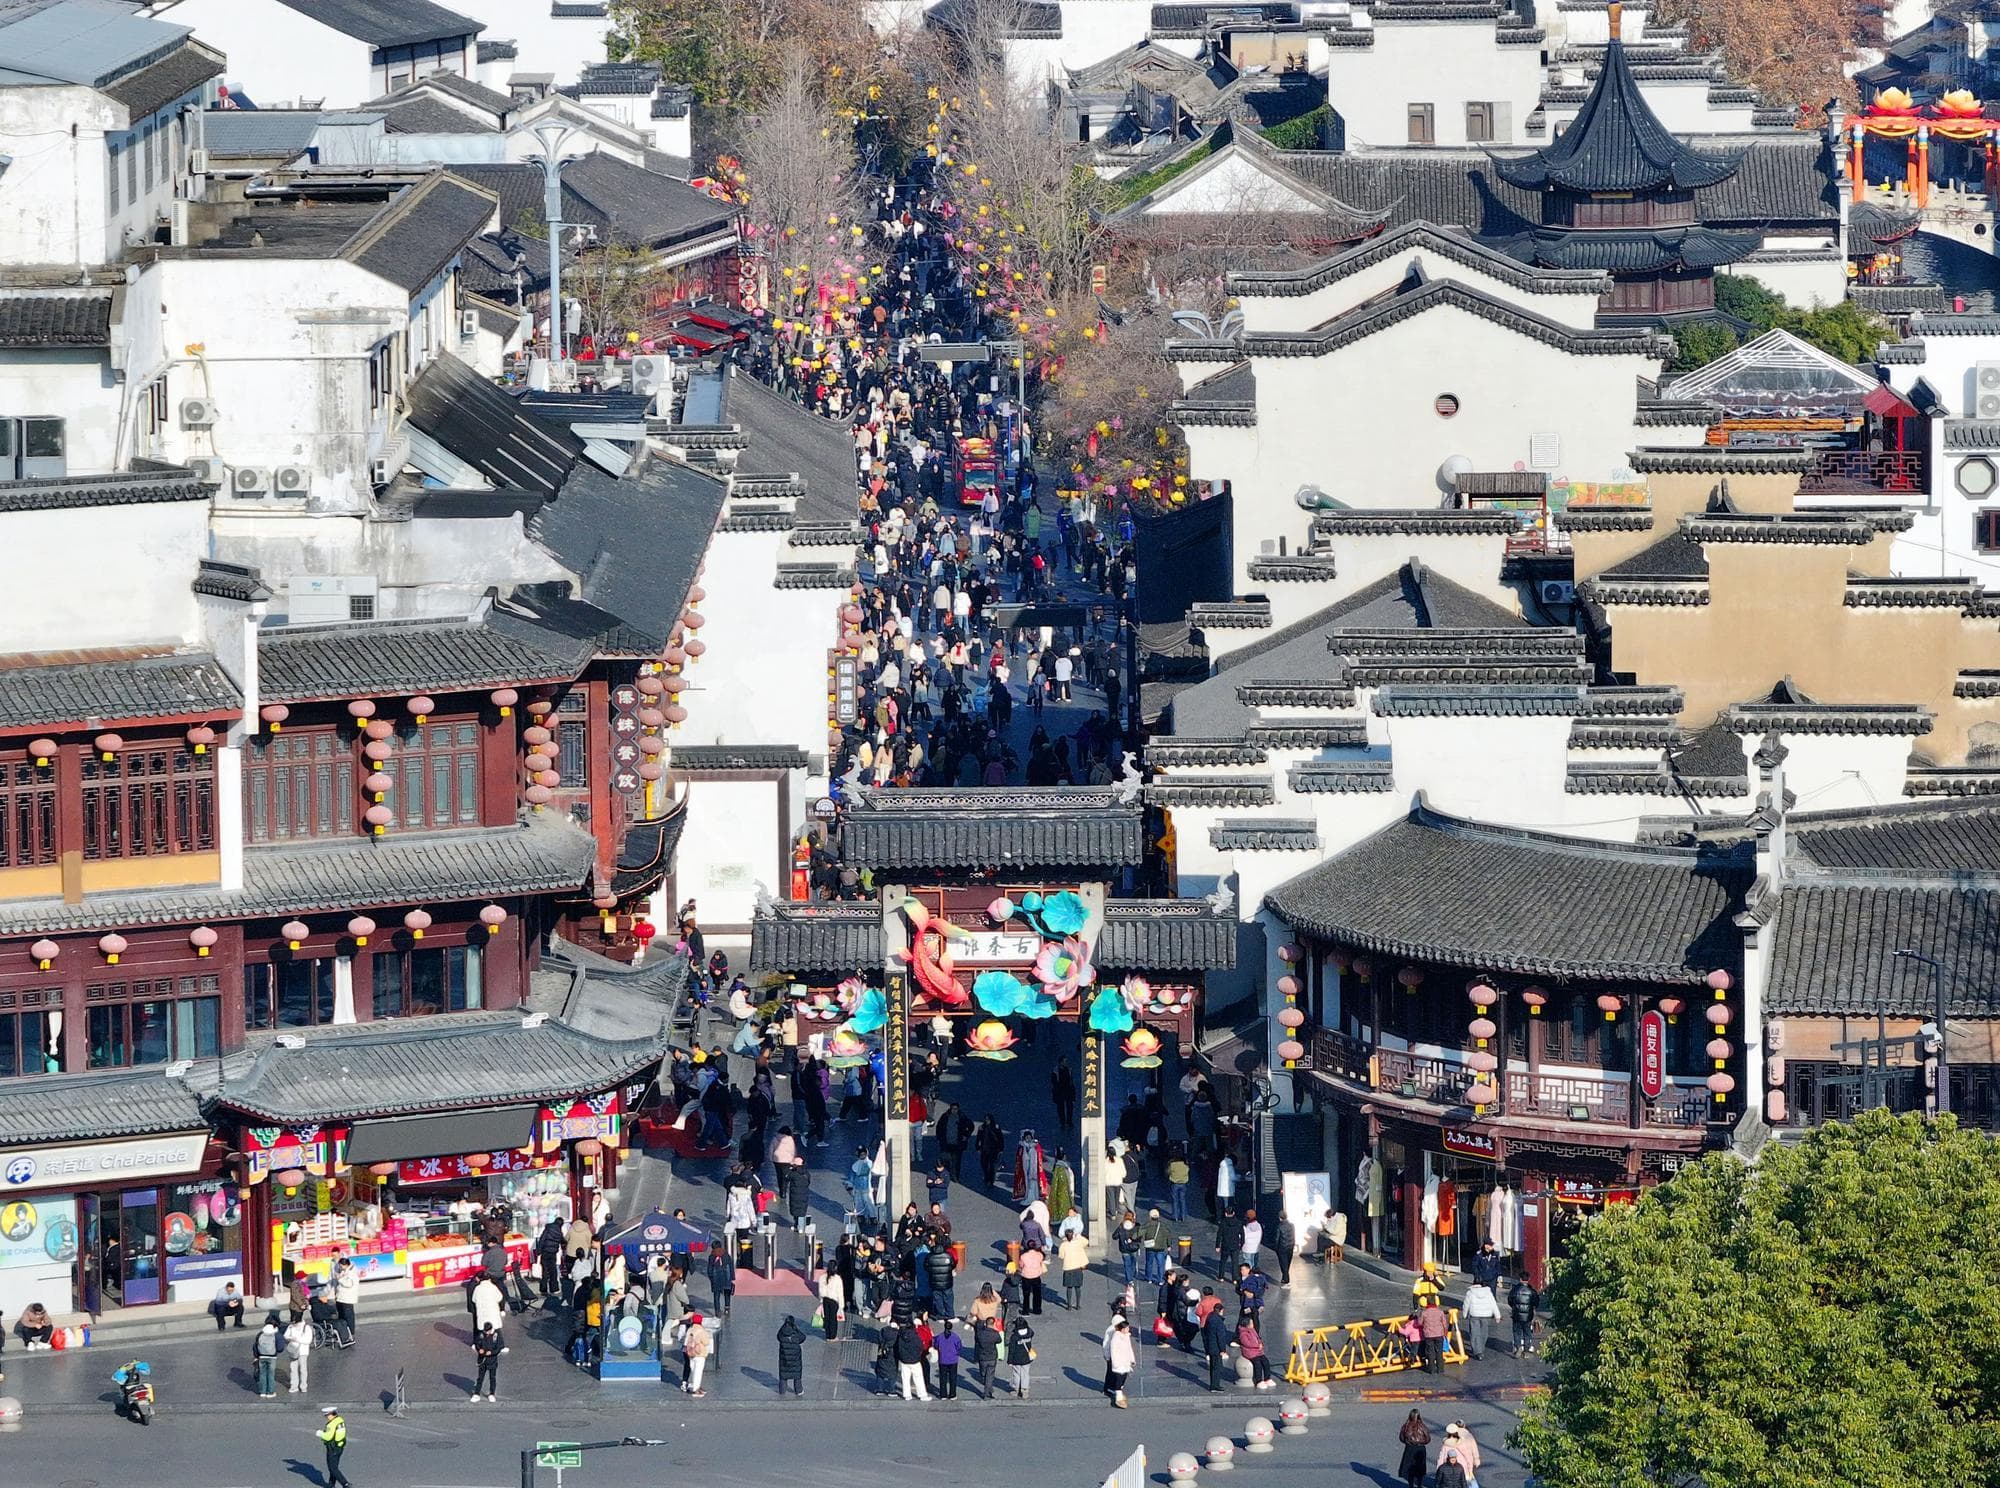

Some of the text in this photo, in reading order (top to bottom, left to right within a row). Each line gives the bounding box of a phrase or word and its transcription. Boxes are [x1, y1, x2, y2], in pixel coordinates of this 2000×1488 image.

[1646, 1024, 1658, 1085] 海友酒店
[44, 1149, 188, 1176] 茶百道 ChaPanda
